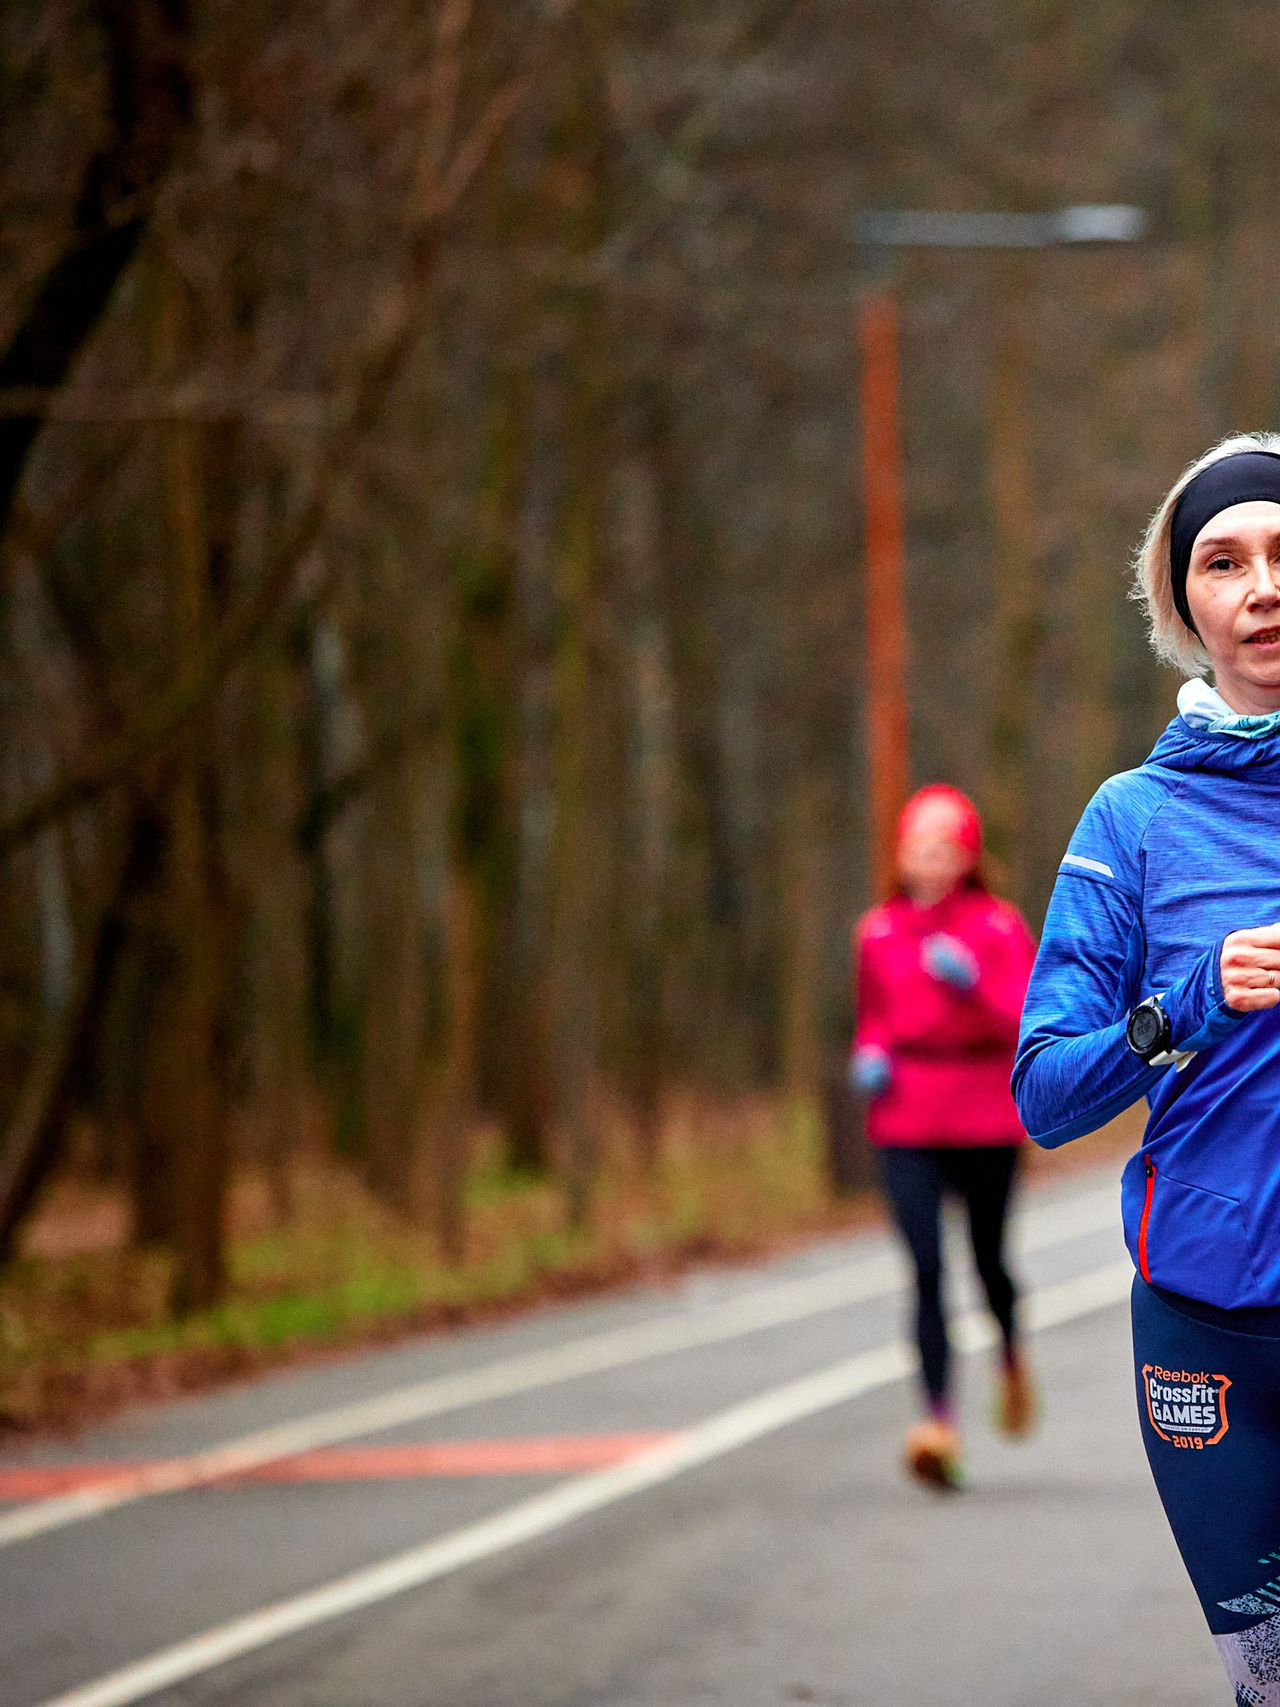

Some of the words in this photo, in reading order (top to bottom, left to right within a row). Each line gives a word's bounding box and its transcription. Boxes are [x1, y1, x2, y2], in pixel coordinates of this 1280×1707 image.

[1154, 1365, 1210, 1384] Reebok
[1151, 1401, 1217, 1425] GAMES
[1172, 1435, 1204, 1450] 2019
